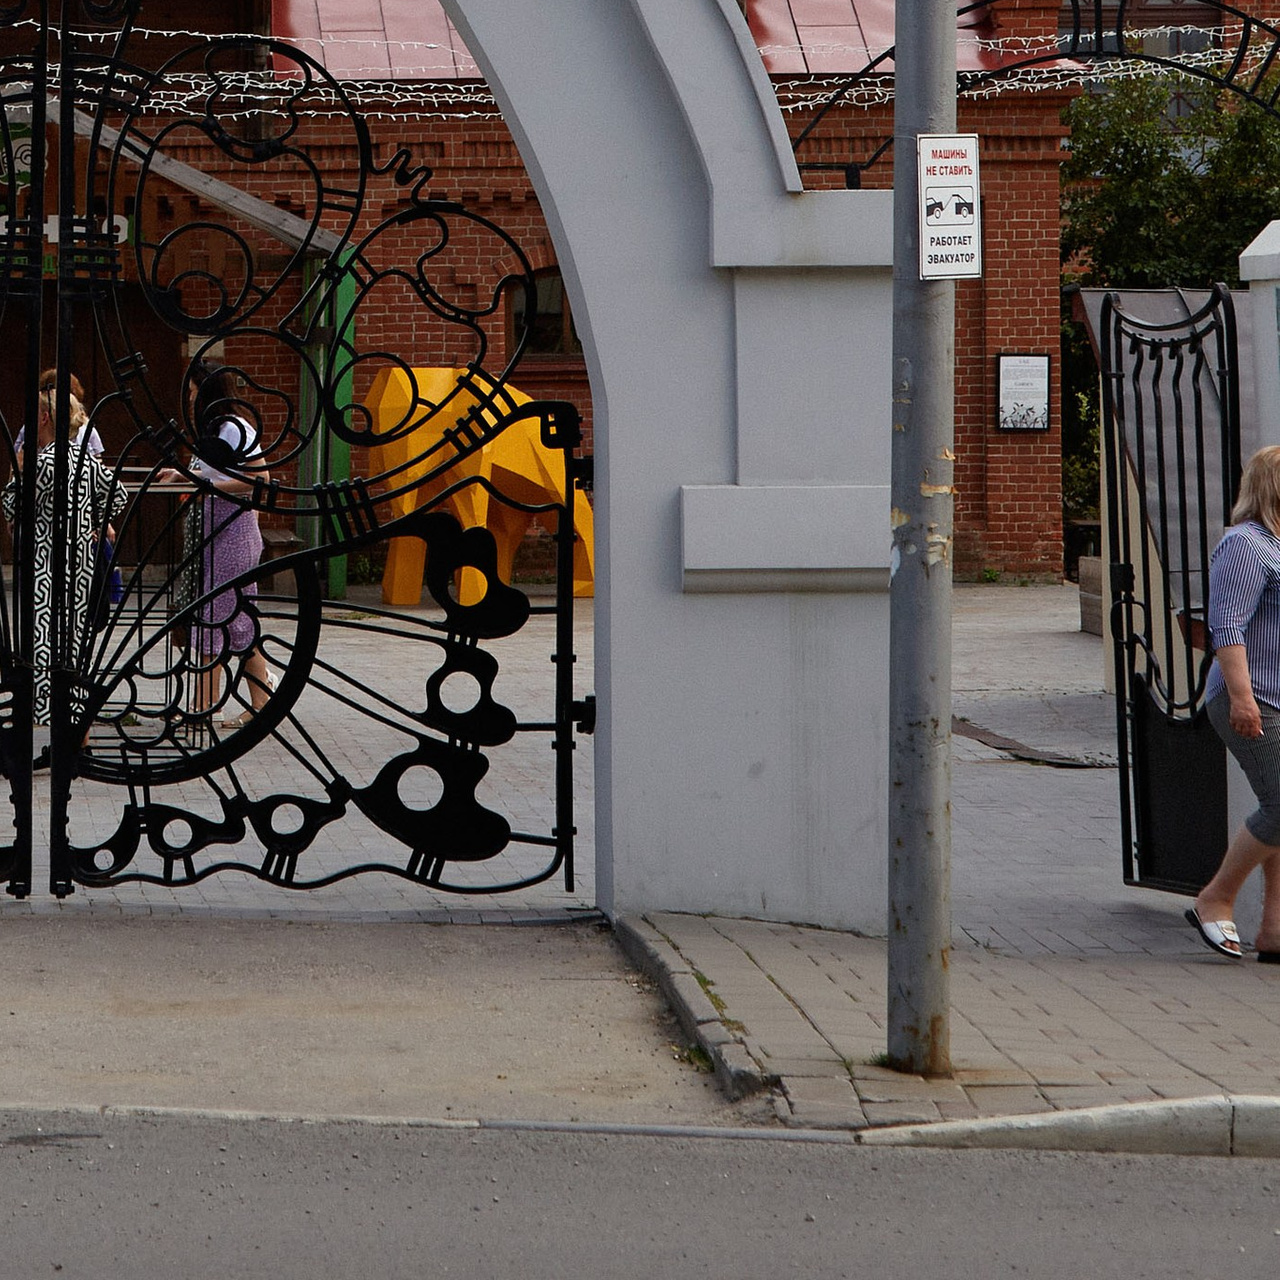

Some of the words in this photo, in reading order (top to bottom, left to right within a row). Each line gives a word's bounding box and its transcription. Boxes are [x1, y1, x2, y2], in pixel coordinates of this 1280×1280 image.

[931, 149, 967, 159] МАШИНЫ
[926, 166, 937, 176] НЕ
[939, 166, 973, 175] СТАВИТЬ
[930, 236, 972, 246] РАБОТАЕТ
[927, 253, 975, 264] ЭВАКУАТОР
